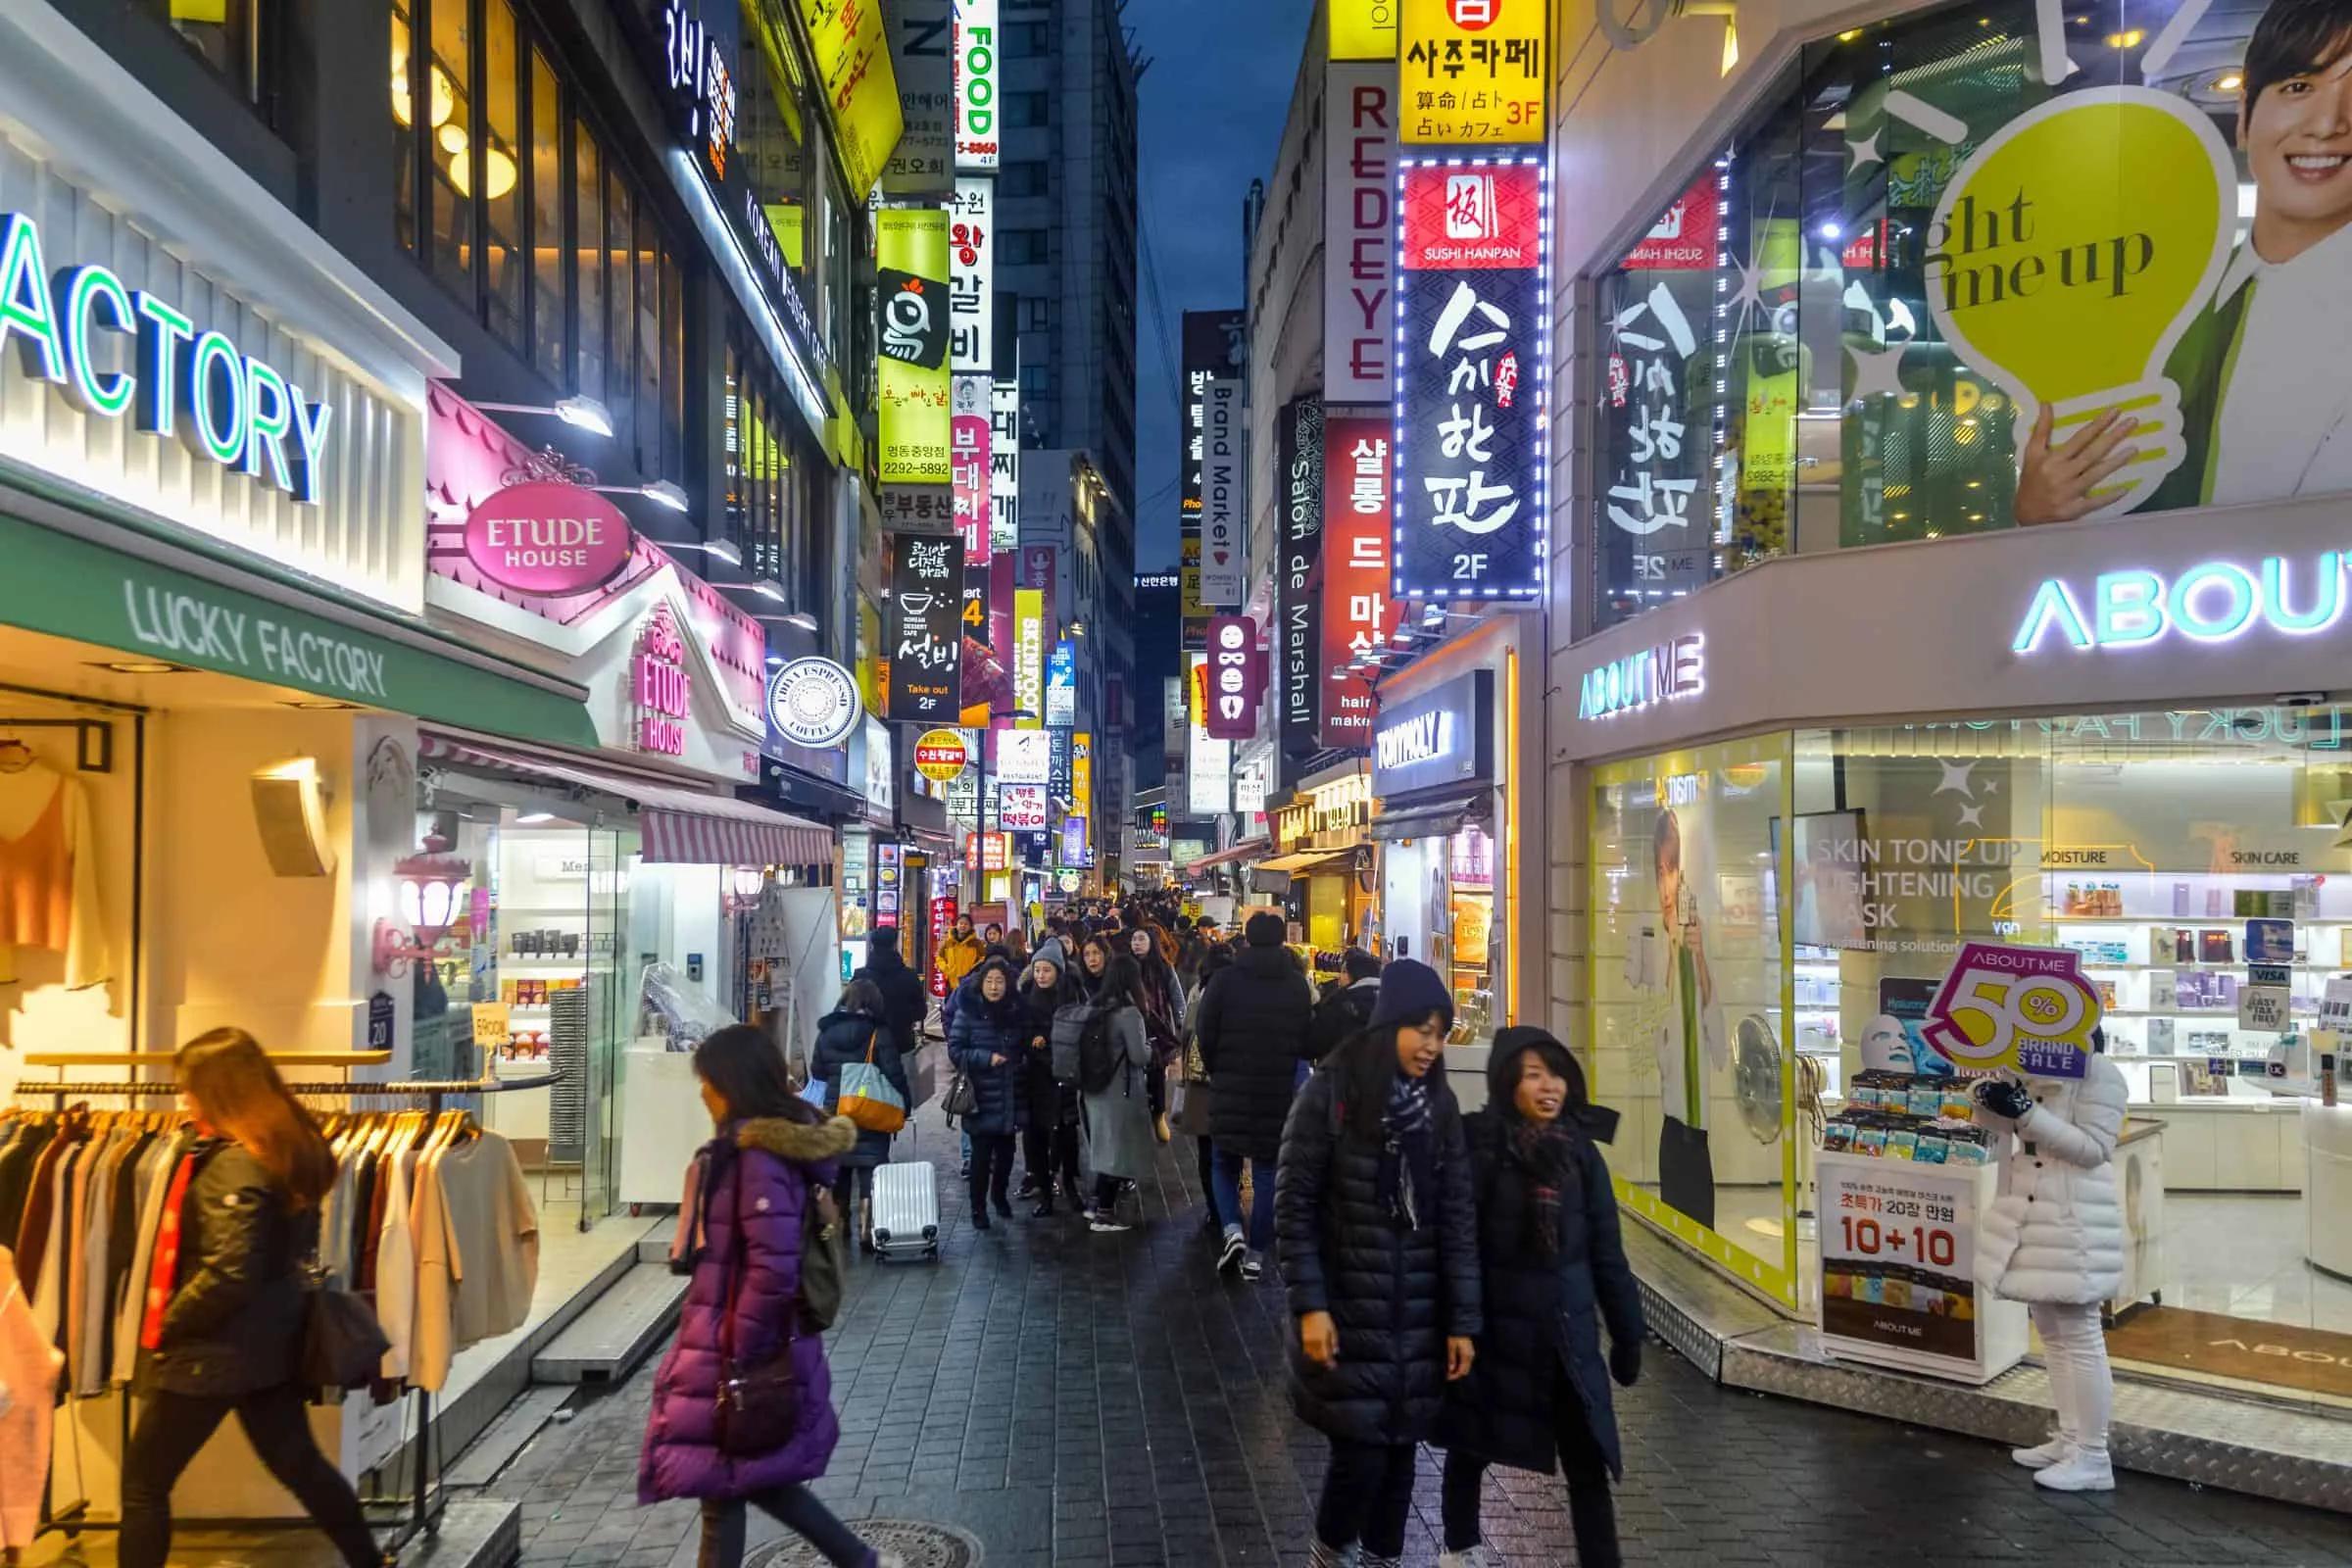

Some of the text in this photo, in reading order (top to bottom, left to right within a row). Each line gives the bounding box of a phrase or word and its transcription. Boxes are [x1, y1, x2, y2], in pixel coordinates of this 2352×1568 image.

[1407, 39, 1539, 78] 사주카페
[967, 27, 993, 135] FOOD
[1506, 102, 1540, 125] 3F
[950, 192, 984, 215] 수원
[1349, 86, 1388, 380] REDEYE
[1424, 247, 1521, 261] SUSHI HANPAN
[1941, 230, 2153, 313] me up
[950, 223, 985, 364] 왕갈비
[0, 212, 332, 506] ACTORY
[887, 446, 945, 458] 명동중앙점
[884, 462, 949, 475] 2292-5892
[1213, 387, 1233, 548] Brand Market
[1349, 438, 1388, 514] 샬롱
[952, 427, 980, 551] 부대찌개
[896, 493, 952, 519] 부동산
[486, 518, 605, 548] ETUDE
[505, 549, 588, 567] HOUSE
[912, 541, 951, 556] 코리안
[1349, 537, 1386, 568] 드
[908, 557, 945, 568] 디저트
[919, 566, 949, 578] 카페
[1453, 554, 1488, 579] 2F
[1141, 575, 1178, 587] 신한은행
[1292, 460, 1309, 723] Salon de Marshall
[2012, 551, 2352, 652] ABOU
[125, 580, 387, 698] LUCKY FACTORY
[643, 656, 691, 720] ETUDE
[804, 666, 848, 708] ESPRESSO
[907, 684, 949, 695] Take out
[1578, 632, 1705, 721] ABOUT ME
[919, 697, 936, 710] 2F
[789, 721, 833, 737] COFFEE
[1051, 739, 1064, 781] 돈까스
[1818, 839, 2022, 865] SKIN TONE UP
[2039, 851, 2106, 863] MOISTURE
[2231, 852, 2299, 864] SKIN CARE
[1830, 903, 1898, 928] ASK
[1972, 952, 2066, 973] ABOUT ME
[2255, 968, 2286, 981] VISA
[2018, 1037, 2076, 1055] BRAND
[2017, 1052, 2074, 1071] SALE
[1841, 1192, 1883, 1212] 초특가
[1886, 1199, 1920, 1217] 20장
[1927, 1204, 1955, 1223] 만원
[1841, 1216, 1954, 1267] 10+10
